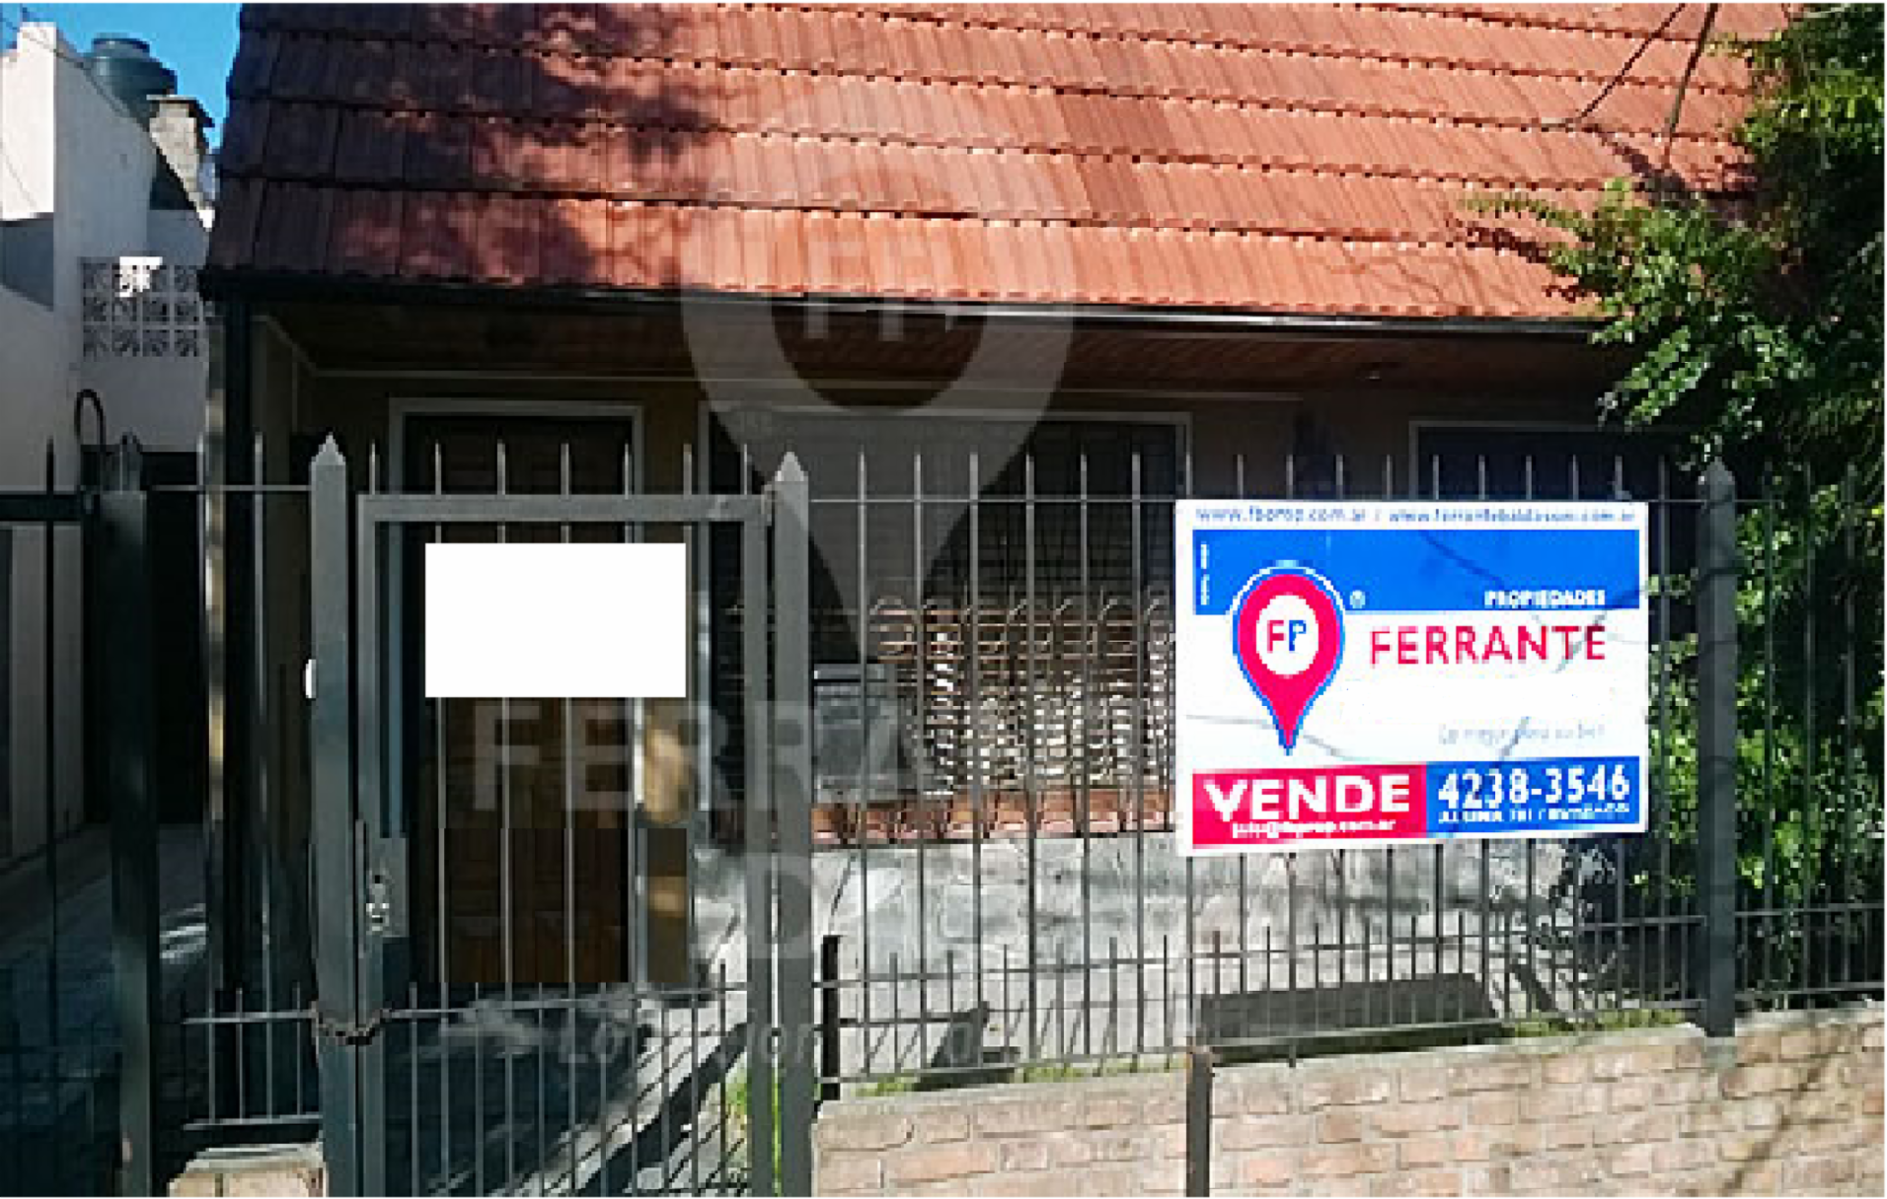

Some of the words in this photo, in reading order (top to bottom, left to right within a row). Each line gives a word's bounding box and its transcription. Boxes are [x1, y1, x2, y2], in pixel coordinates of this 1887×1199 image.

[1266, 619, 1308, 654] FP
[1369, 625, 1606, 665] FERRANTE
[1203, 774, 1410, 822] VENDE
[1438, 764, 1630, 809] 4238-3546
